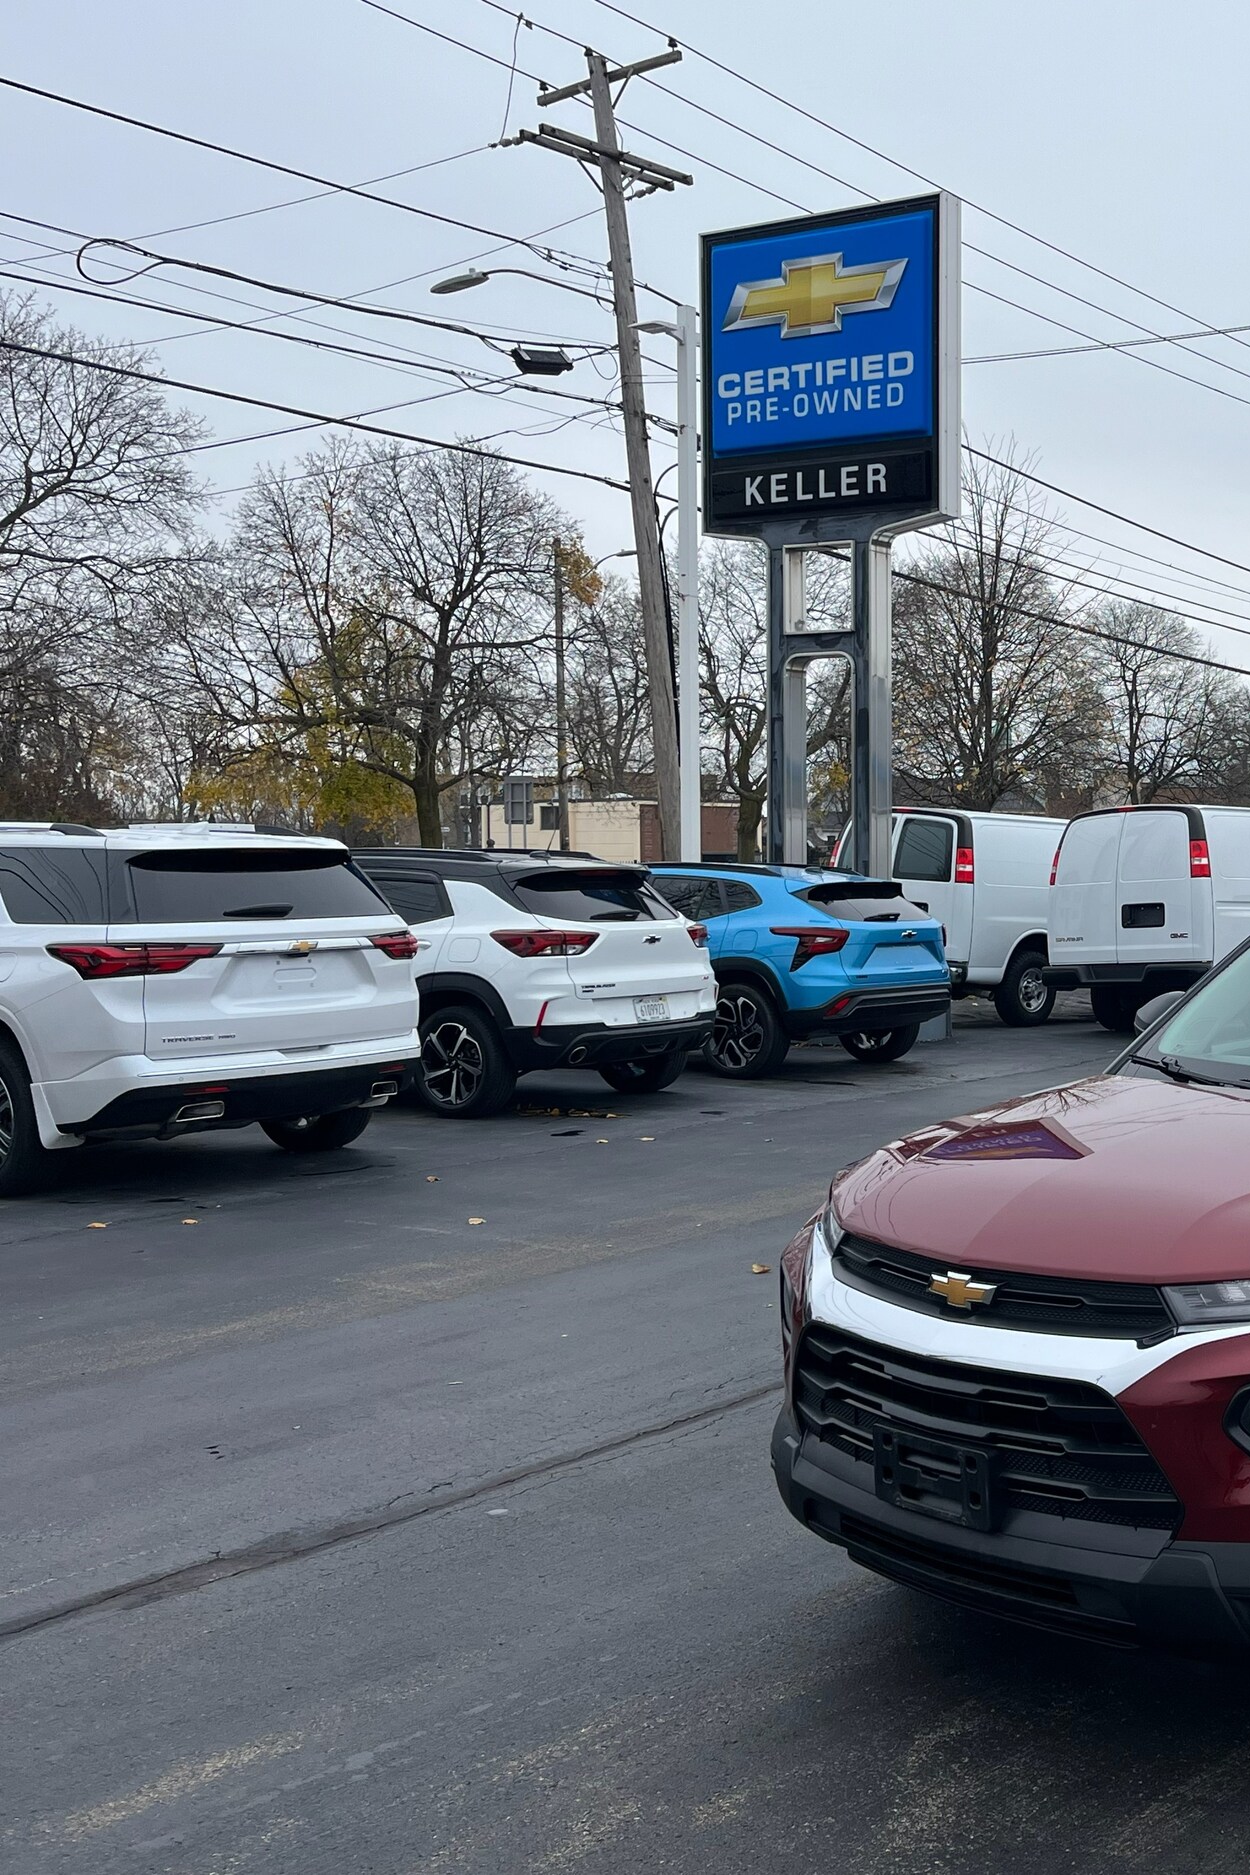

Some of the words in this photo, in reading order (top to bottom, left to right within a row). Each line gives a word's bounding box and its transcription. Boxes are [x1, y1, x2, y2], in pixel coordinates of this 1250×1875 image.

[718, 351, 914, 399] CERTIFIED
[727, 382, 904, 426] PRE-OWNED
[745, 462, 887, 506] KELLER
[161, 1035, 214, 1043] TRAVERSE
